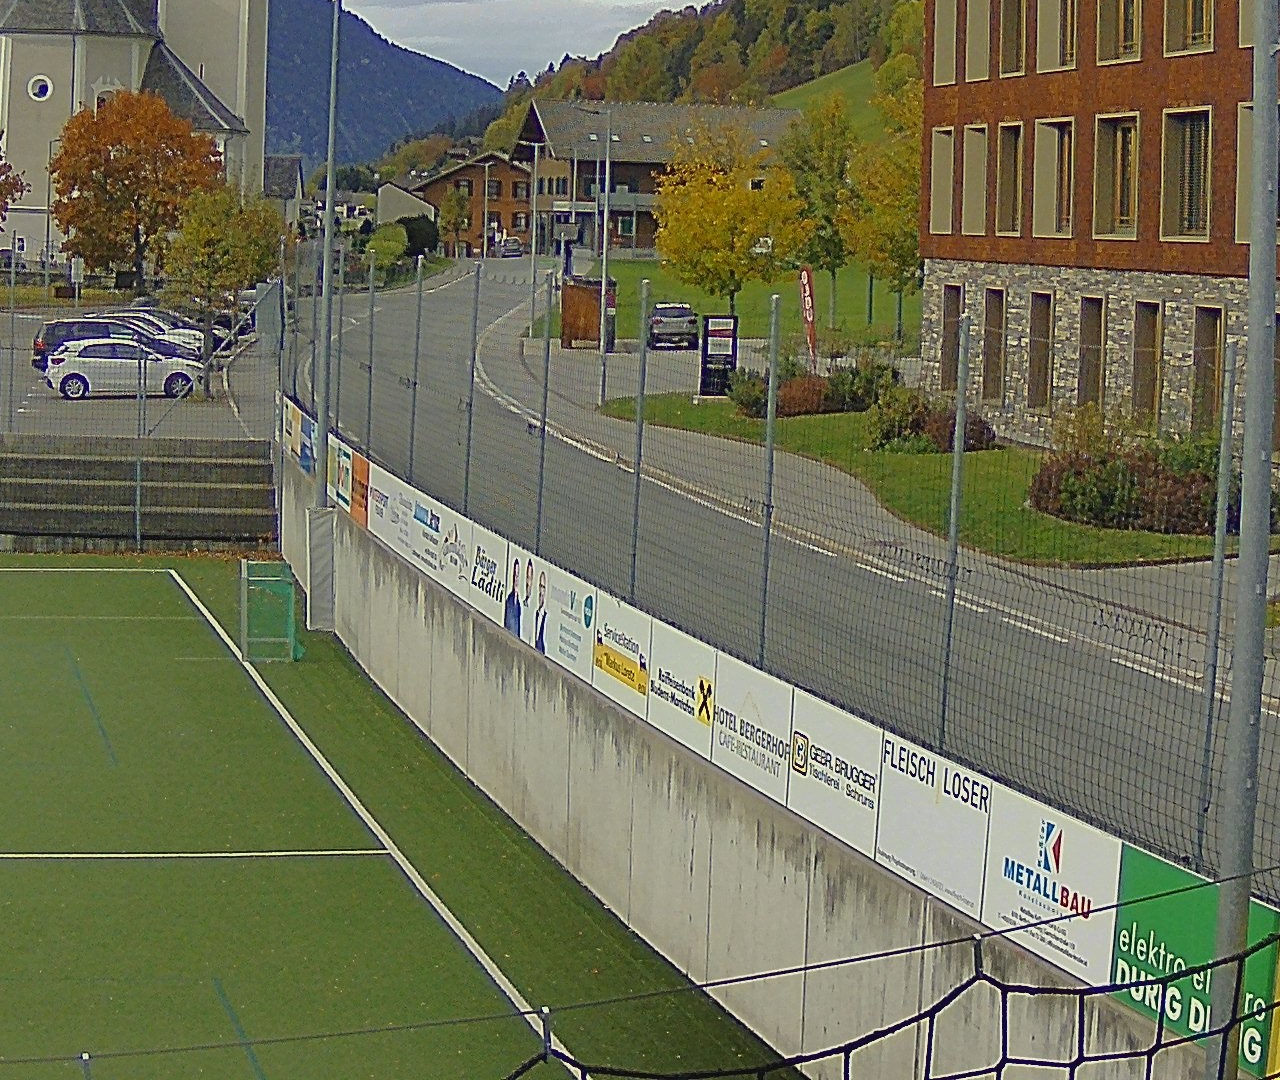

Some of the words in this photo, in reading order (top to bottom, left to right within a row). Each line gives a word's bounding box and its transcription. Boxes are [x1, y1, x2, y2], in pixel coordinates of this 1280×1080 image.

[714, 705, 737, 733] HOTEL
[739, 719, 791, 761] BERGERHOF
[883, 739, 936, 788] FLEISCH
[943, 767, 989, 813] LOSER
[1003, 856, 1092, 919] METALLBAU
[1119, 922, 1186, 975] elektro
